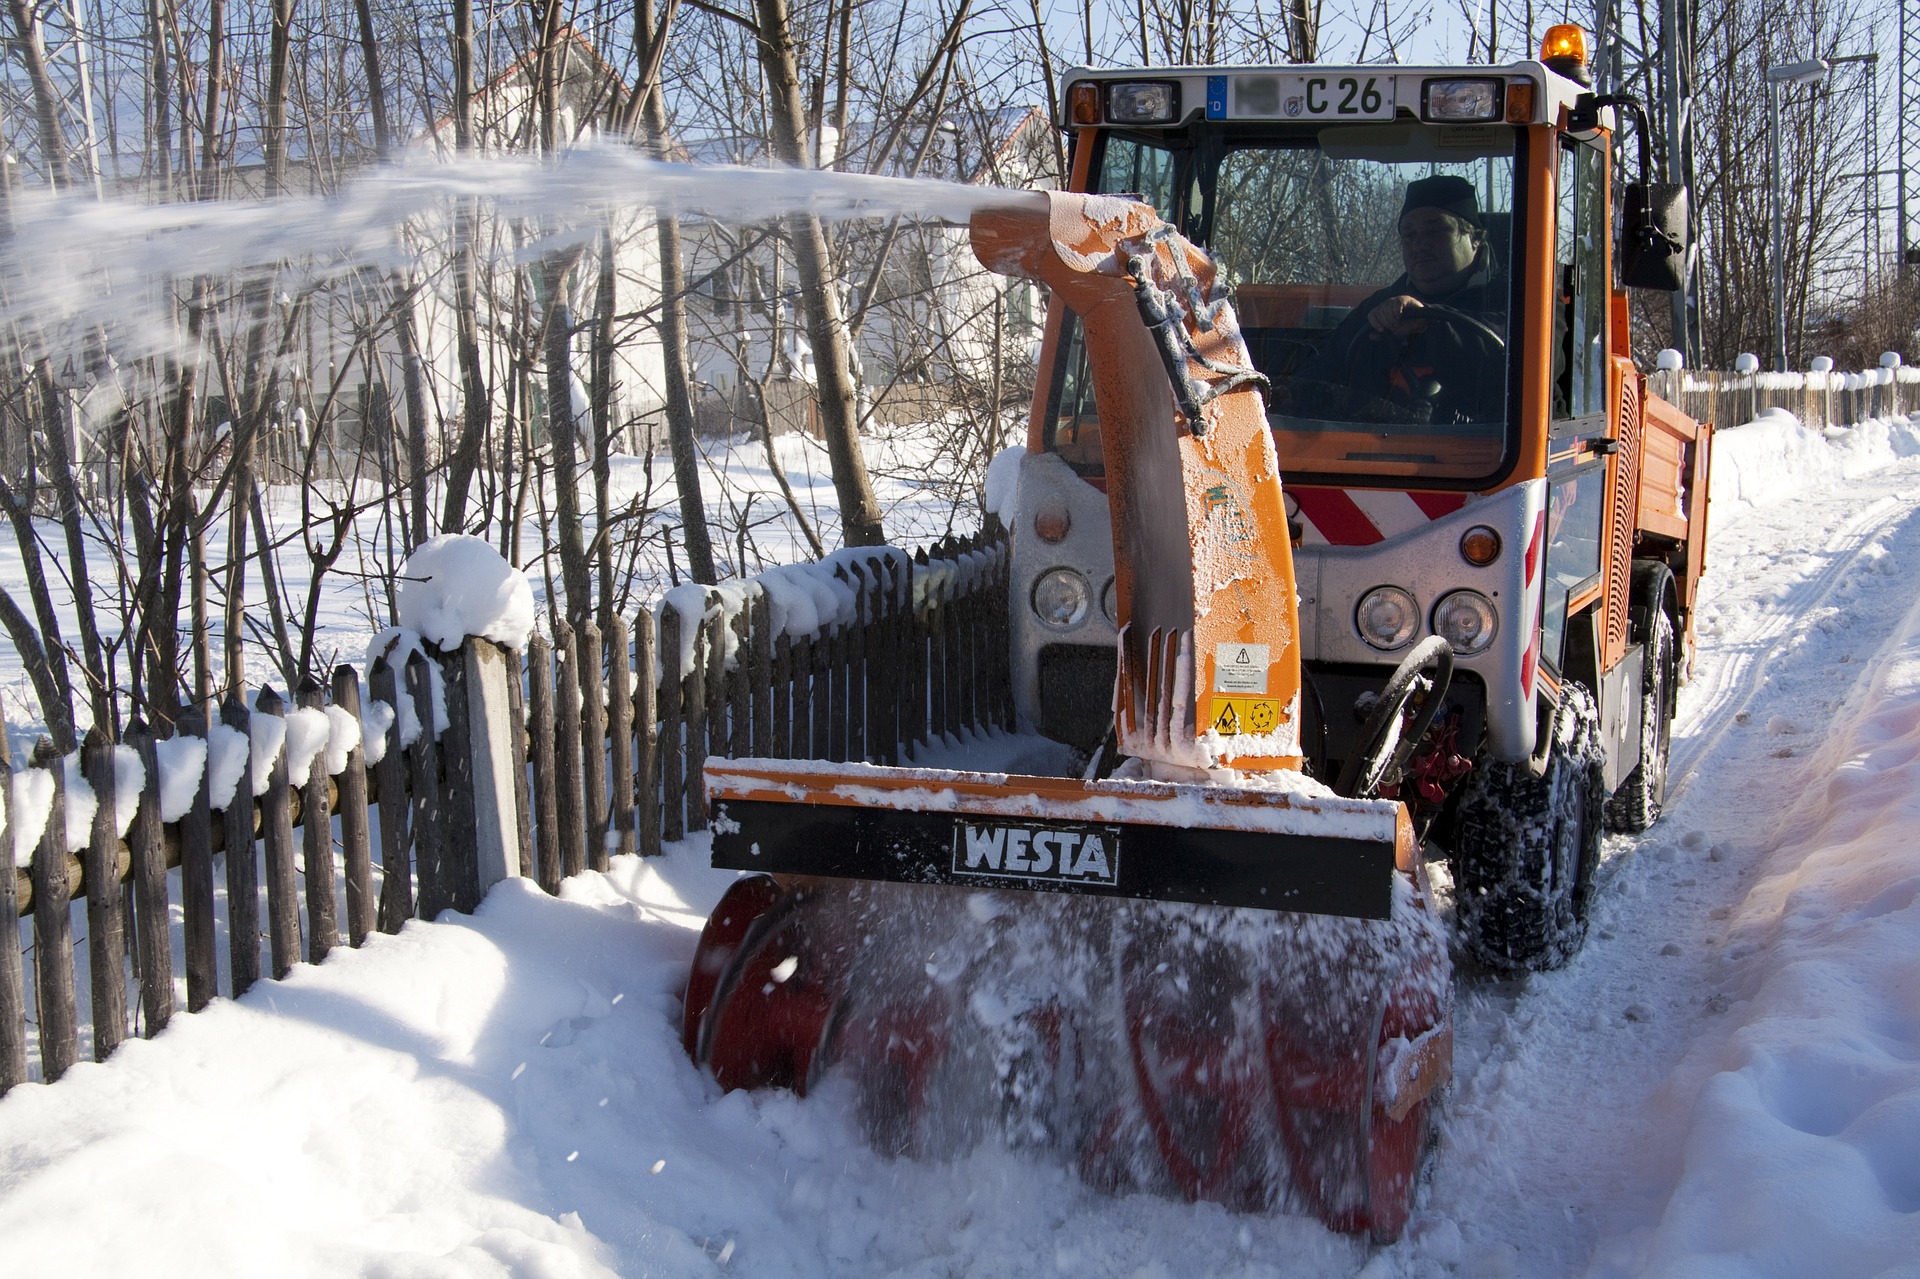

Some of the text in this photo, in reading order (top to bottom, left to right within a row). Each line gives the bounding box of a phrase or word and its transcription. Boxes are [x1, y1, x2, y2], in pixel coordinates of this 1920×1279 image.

[1213, 101, 1221, 111] D
[1306, 78, 1328, 114] C
[1337, 77, 1382, 115] 26
[965, 826, 1111, 878] WESTA
